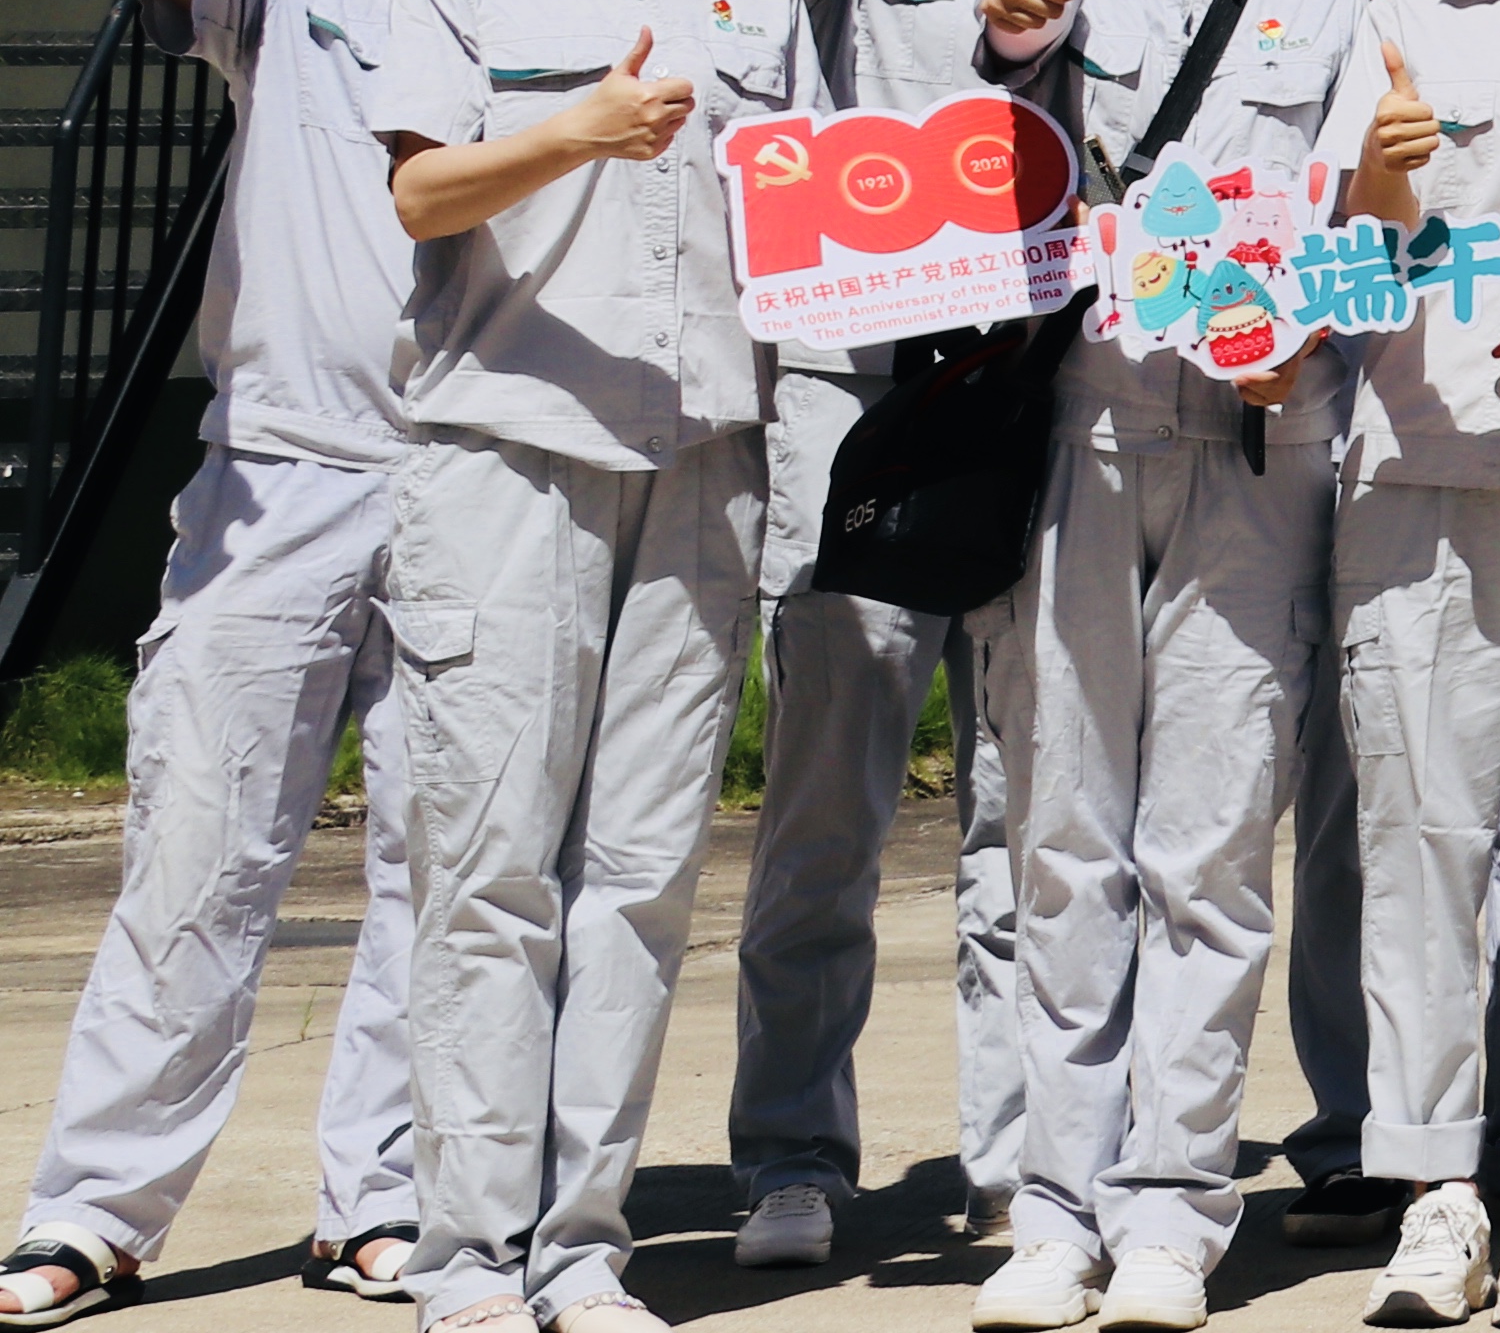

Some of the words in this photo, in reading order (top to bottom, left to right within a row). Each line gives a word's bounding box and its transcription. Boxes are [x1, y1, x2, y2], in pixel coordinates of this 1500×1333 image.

[856, 174, 895, 191] 1921
[970, 155, 1008, 173] 2021
[755, 236, 1092, 314] 庆祝中国共产党成立100周年
[761, 319, 792, 334] The
[798, 309, 843, 327] 100th
[848, 290, 946, 317] Anniversary
[951, 286, 967, 301] of
[972, 281, 997, 296] the
[1002, 266, 1078, 288] Founding
[815, 327, 845, 341] The
[850, 307, 944, 334] Communist
[949, 300, 990, 319] Party
[996, 296, 1012, 311] of
[1016, 286, 1063, 304] China
[845, 499, 876, 532] EOS
